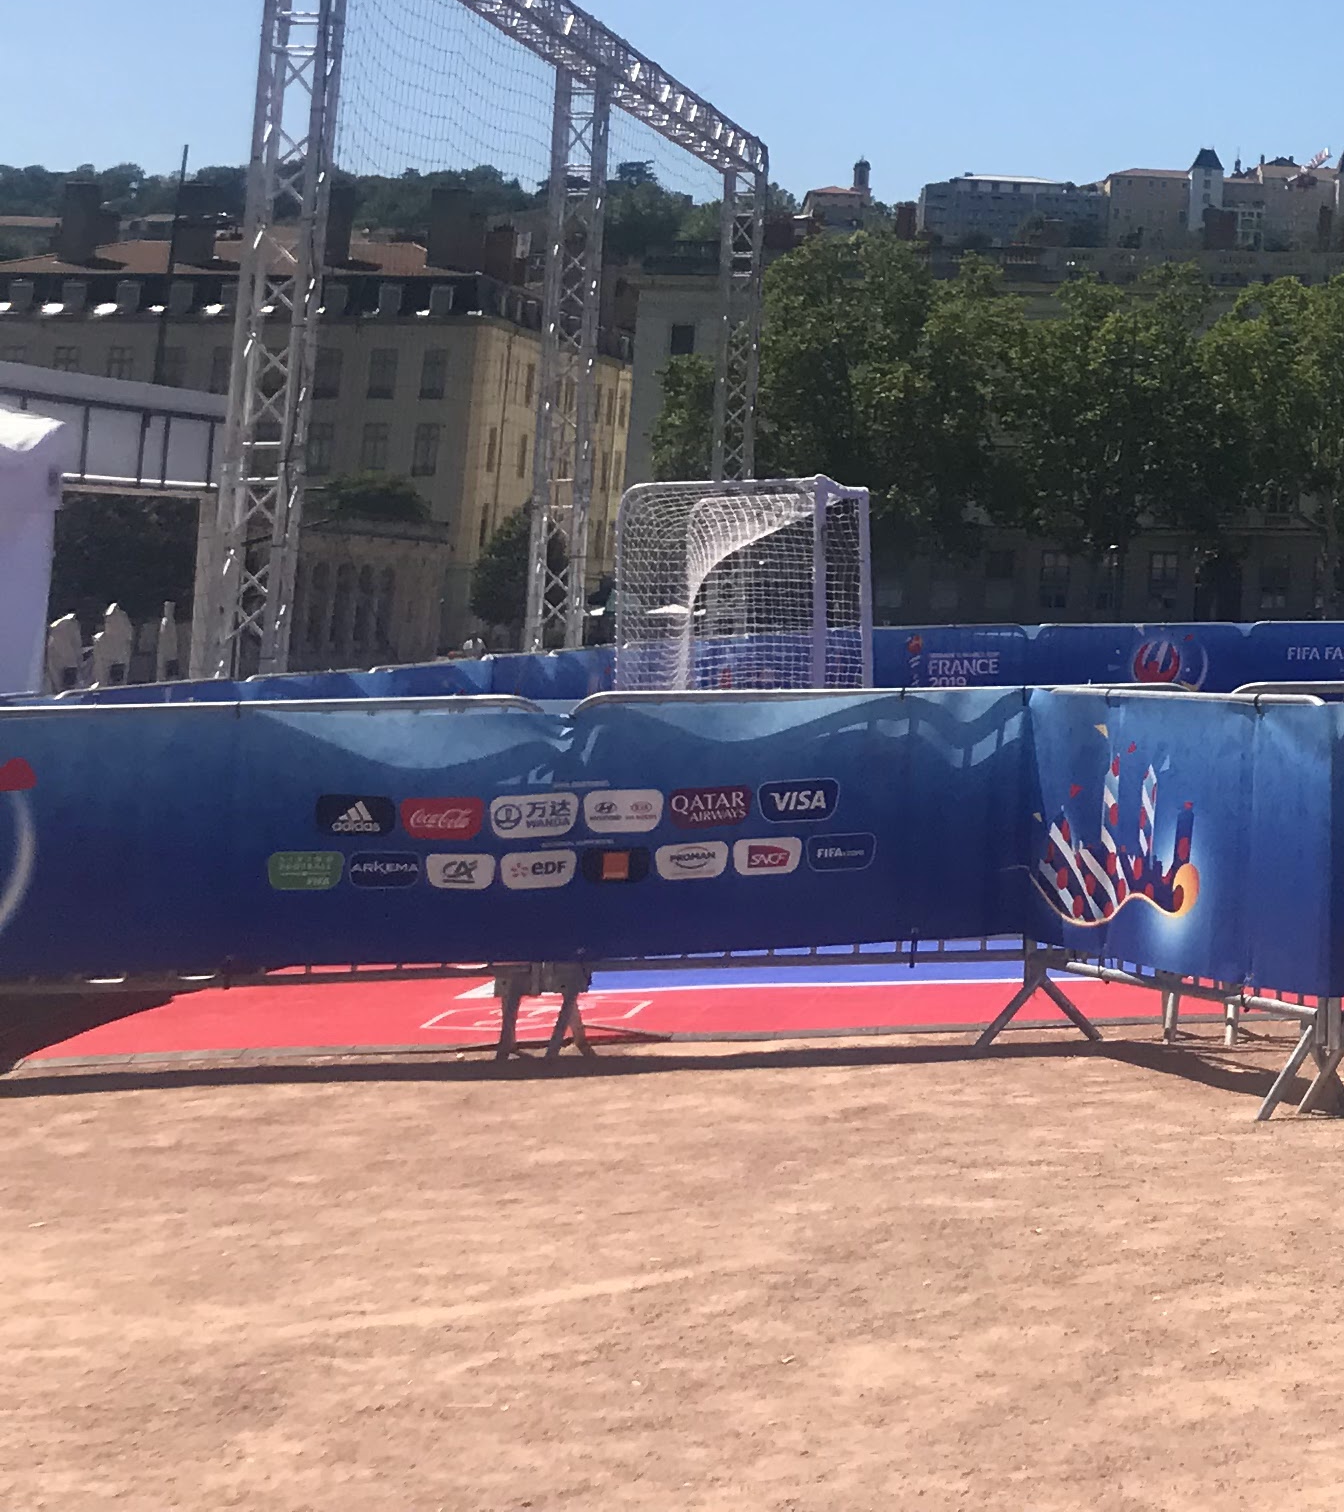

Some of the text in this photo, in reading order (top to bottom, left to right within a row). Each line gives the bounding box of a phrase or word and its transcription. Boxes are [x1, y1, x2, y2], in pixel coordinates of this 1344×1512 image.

[1287, 647, 1321, 661] FIFA
[927, 658, 1000, 676] FRANCE
[671, 791, 746, 815] QATAR
[769, 790, 826, 812] VISA
[526, 799, 572, 818] 万达
[690, 807, 747, 822] AIRWAYS
[331, 819, 381, 832] adidas
[526, 817, 571, 829] WANDA
[669, 850, 716, 864] PROMAN
[751, 852, 788, 866] SNCF
[350, 860, 420, 874] ARKEMA
